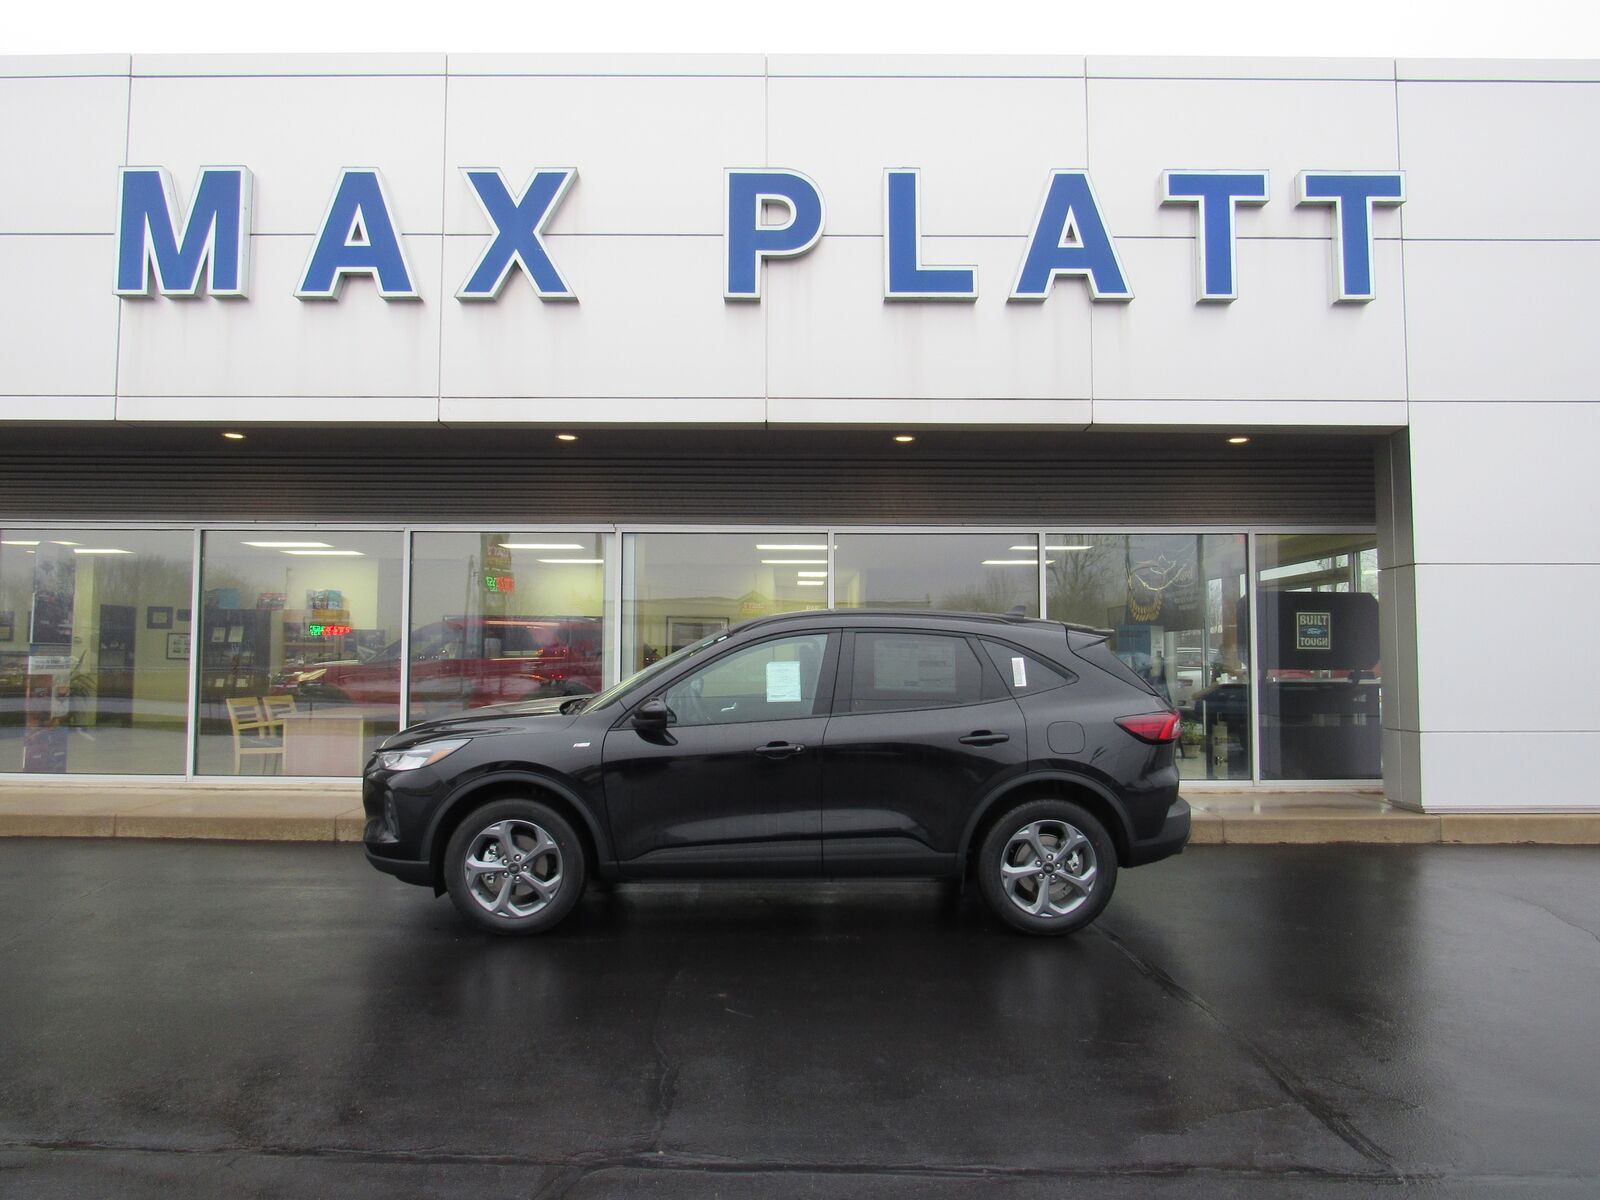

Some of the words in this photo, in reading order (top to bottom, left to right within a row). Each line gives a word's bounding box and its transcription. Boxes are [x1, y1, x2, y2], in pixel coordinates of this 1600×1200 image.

[113, 165, 579, 301] MAX
[723, 167, 1407, 305] PLATT
[1300, 615, 1328, 625] BUILT
[1300, 637, 1328, 647] TOUGH
